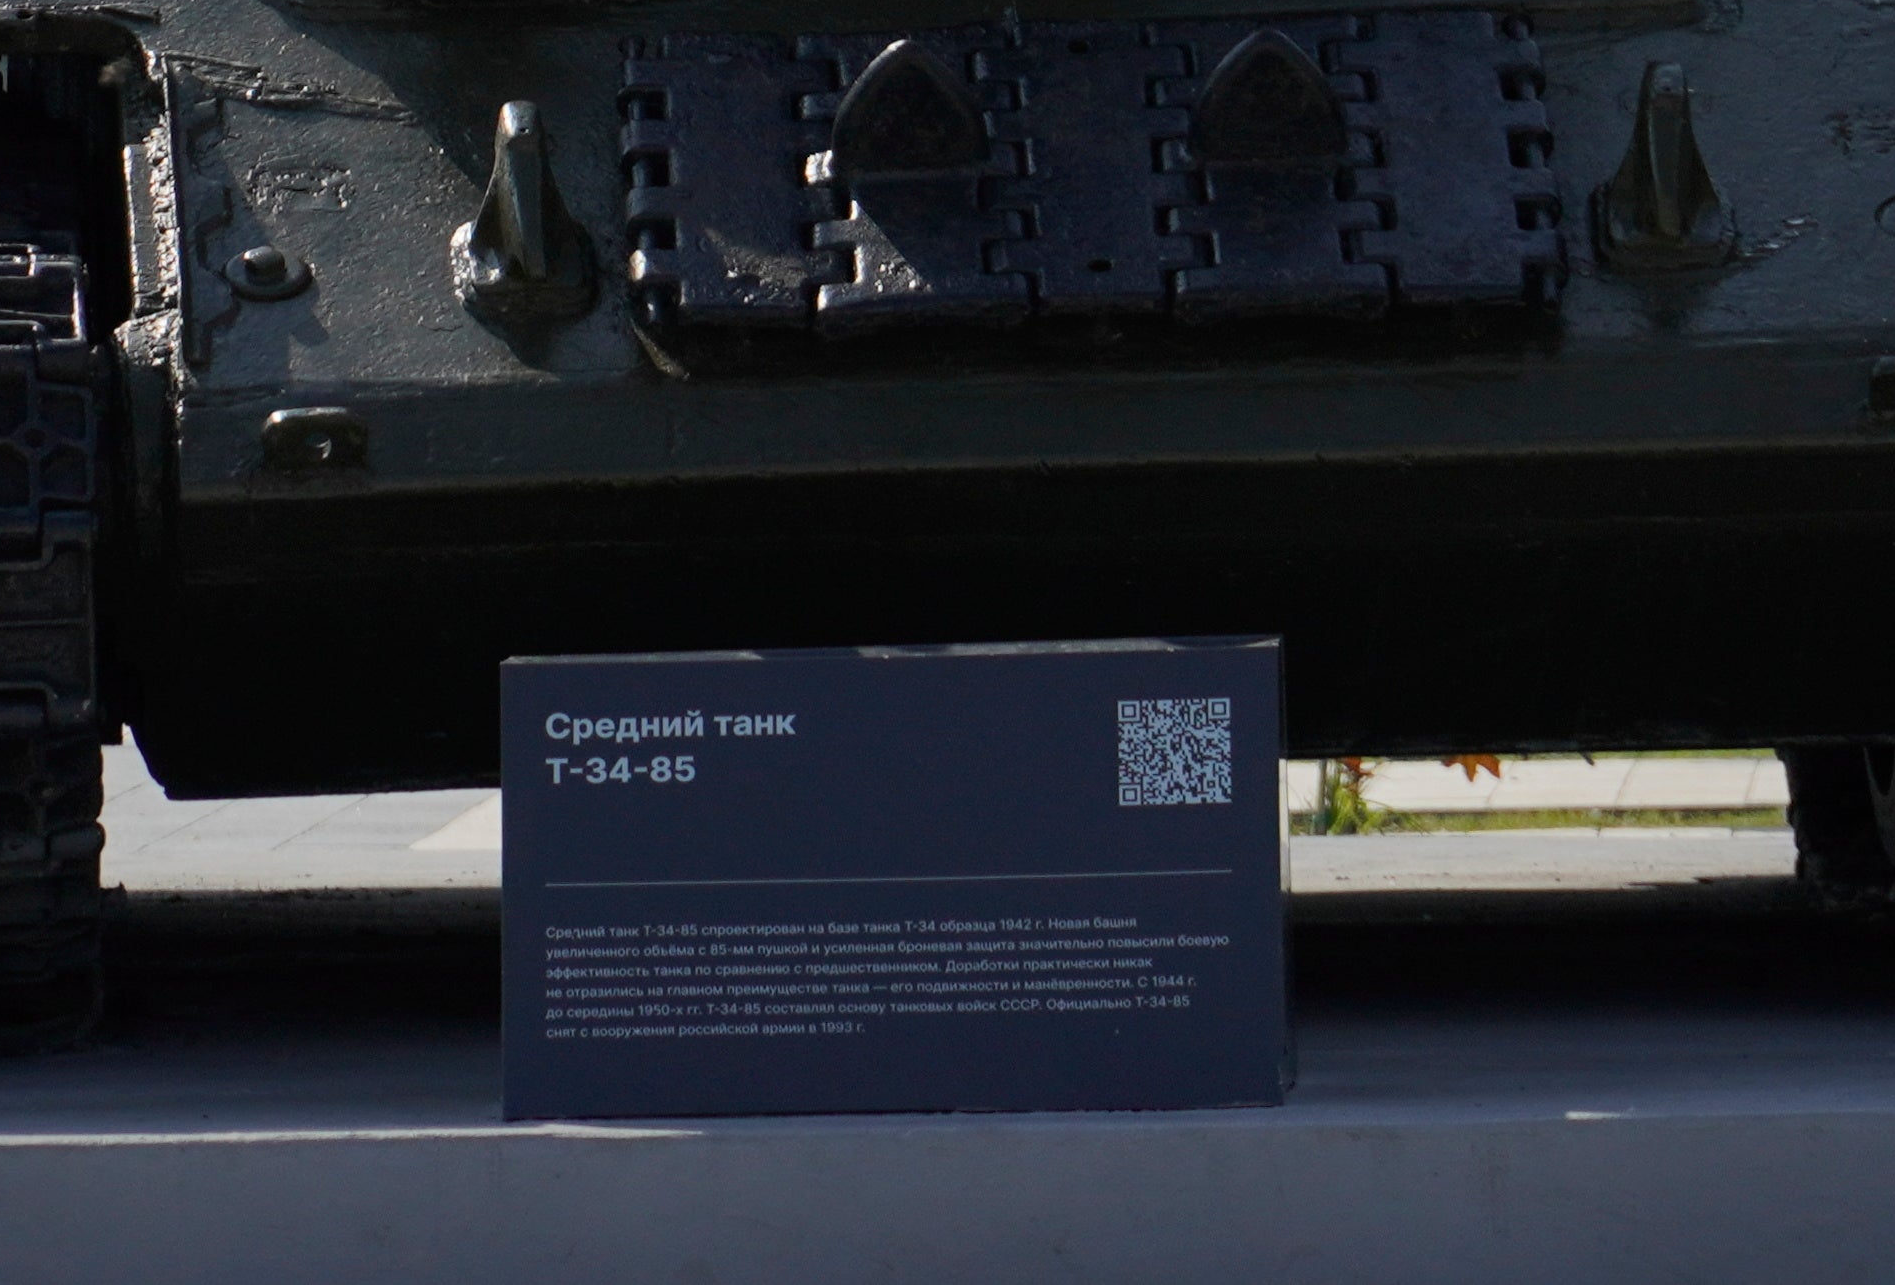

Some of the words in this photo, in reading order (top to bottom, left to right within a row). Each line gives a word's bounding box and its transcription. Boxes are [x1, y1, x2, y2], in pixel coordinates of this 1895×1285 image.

[544, 709, 705, 746] Средний
[713, 713, 797, 736] танк
[544, 755, 697, 784] Т-34-85
[545, 925, 606, 940] Средний
[608, 927, 640, 938] танк
[642, 924, 699, 937] Т-34-85
[700, 924, 806, 938] спроектирован
[807, 924, 825, 934] на
[827, 922, 860, 934] базе
[862, 923, 901, 934] танка
[904, 919, 937, 933] Т-34
[939, 919, 997, 933] образца
[999, 918, 1032, 931] 1942
[1035, 921, 1045, 930] г.
[1047, 918, 1091, 929] Новая
[1092, 916, 1138, 929] башня
[545, 947, 641, 960] увеличенного
[643, 944, 695, 958] объёма
[698, 946, 706, 956] с
[710, 943, 754, 955] 85-мм
[757, 943, 808, 957] пушкой
[811, 944, 820, 954] и
[823, 943, 895, 955] усиленная
[897, 940, 963, 954] броневая
[966, 941, 1016, 953] защита
[1019, 938, 1105, 950] значительно
[1107, 937, 1175, 948] повысили
[1177, 933, 1230, 948] боевую
[545, 964, 651, 980] эффективность
[653, 966, 692, 976] танка
[694, 966, 712, 976] по
[714, 965, 791, 977] сравнению
[793, 965, 803, 974] с
[805, 962, 942, 976] предшественником.
[944, 959, 1020, 973] Доработки
[1022, 959, 1110, 972] практически
[1112, 958, 1153, 968] никак
[545, 989, 563, 998] не
[565, 987, 645, 1000] отразились
[647, 987, 664, 996] на
[666, 985, 724, 997] главном
[726, 983, 828, 997] преимуществе
[832, 984, 870, 993] танка
[889, 983, 914, 992] его
[916, 981, 1009, 994] подвижности
[1011, 981, 1021, 990] и
[1023, 977, 1135, 992] манёвренности.
[1137, 976, 1149, 988] С
[1151, 975, 1185, 988] 1944
[1187, 977, 1197, 986] г.
[544, 1008, 564, 1019] до
[566, 1007, 635, 1020] середины
[637, 1004, 684, 1017] 1950-х
[686, 1005, 703, 1015] гг.
[706, 1002, 762, 1015] Т-34-85
[764, 1004, 835, 1014] составлял
[837, 1003, 887, 1015] основу
[889, 1002, 954, 1013] танковых
[956, 999, 997, 1012] войск
[999, 999, 1043, 1011] СССР.
[1045, 997, 1132, 1011] Официально
[1134, 995, 1191, 1008] Т-34-85
[546, 1028, 577, 1038] снят
[579, 1028, 588, 1038] с
[591, 1026, 675, 1038] вооружения
[678, 1023, 759, 1037] российской
[762, 1024, 806, 1035] армии
[808, 1023, 817, 1034] в
[820, 1021, 853, 1033] 1993
[856, 1024, 866, 1032] г.
